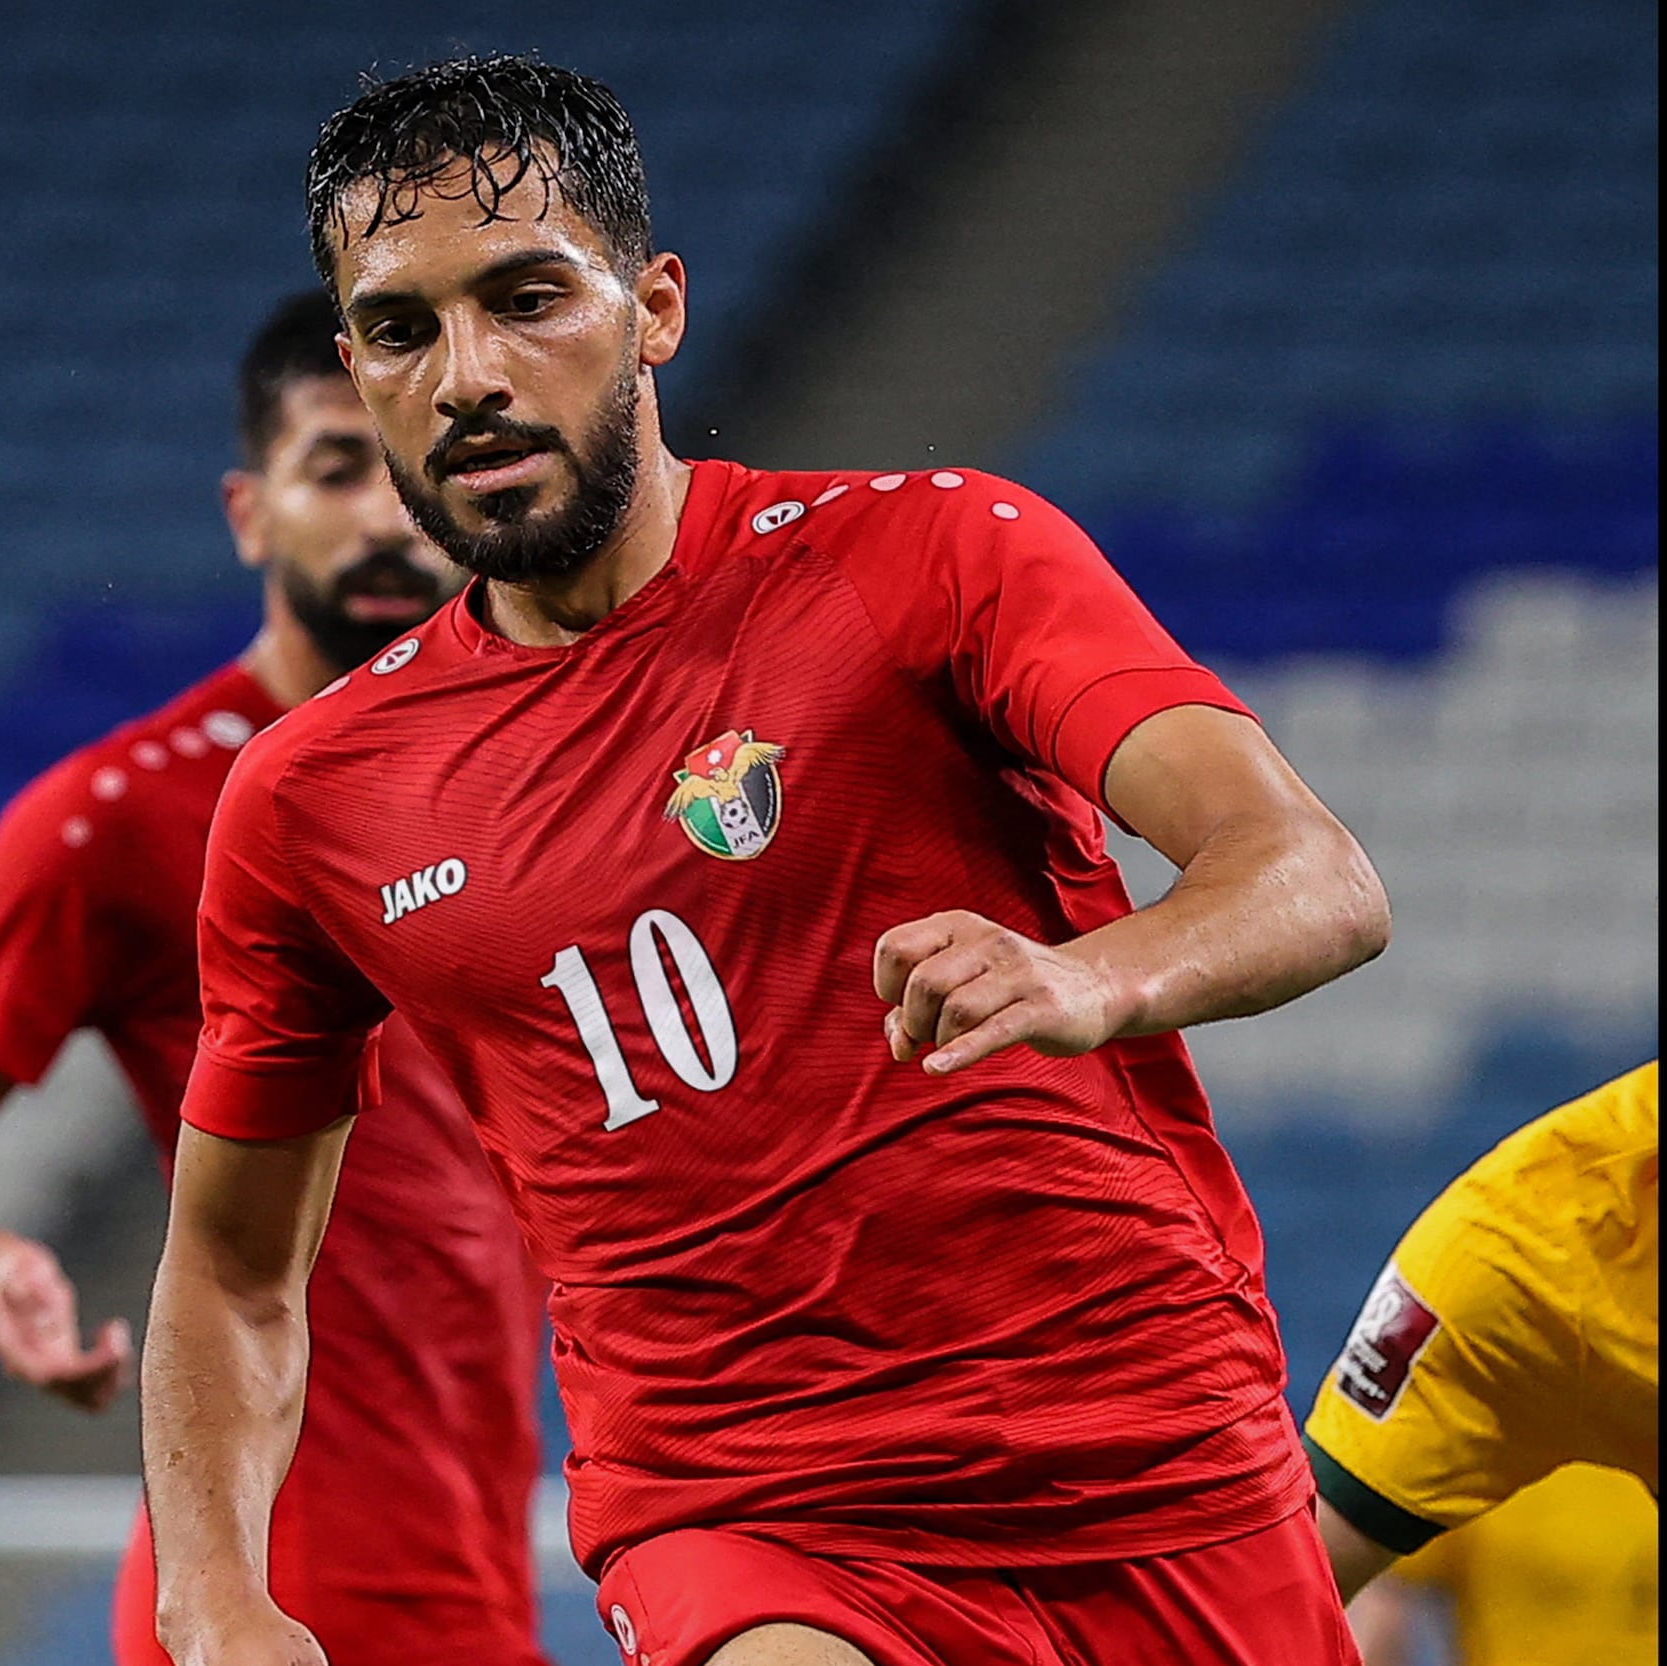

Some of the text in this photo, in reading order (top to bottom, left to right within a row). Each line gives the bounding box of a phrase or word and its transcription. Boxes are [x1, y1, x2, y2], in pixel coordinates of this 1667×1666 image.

[733, 830, 760, 849] JFA
[379, 857, 467, 925] JAKO
[539, 908, 740, 1133] 10
